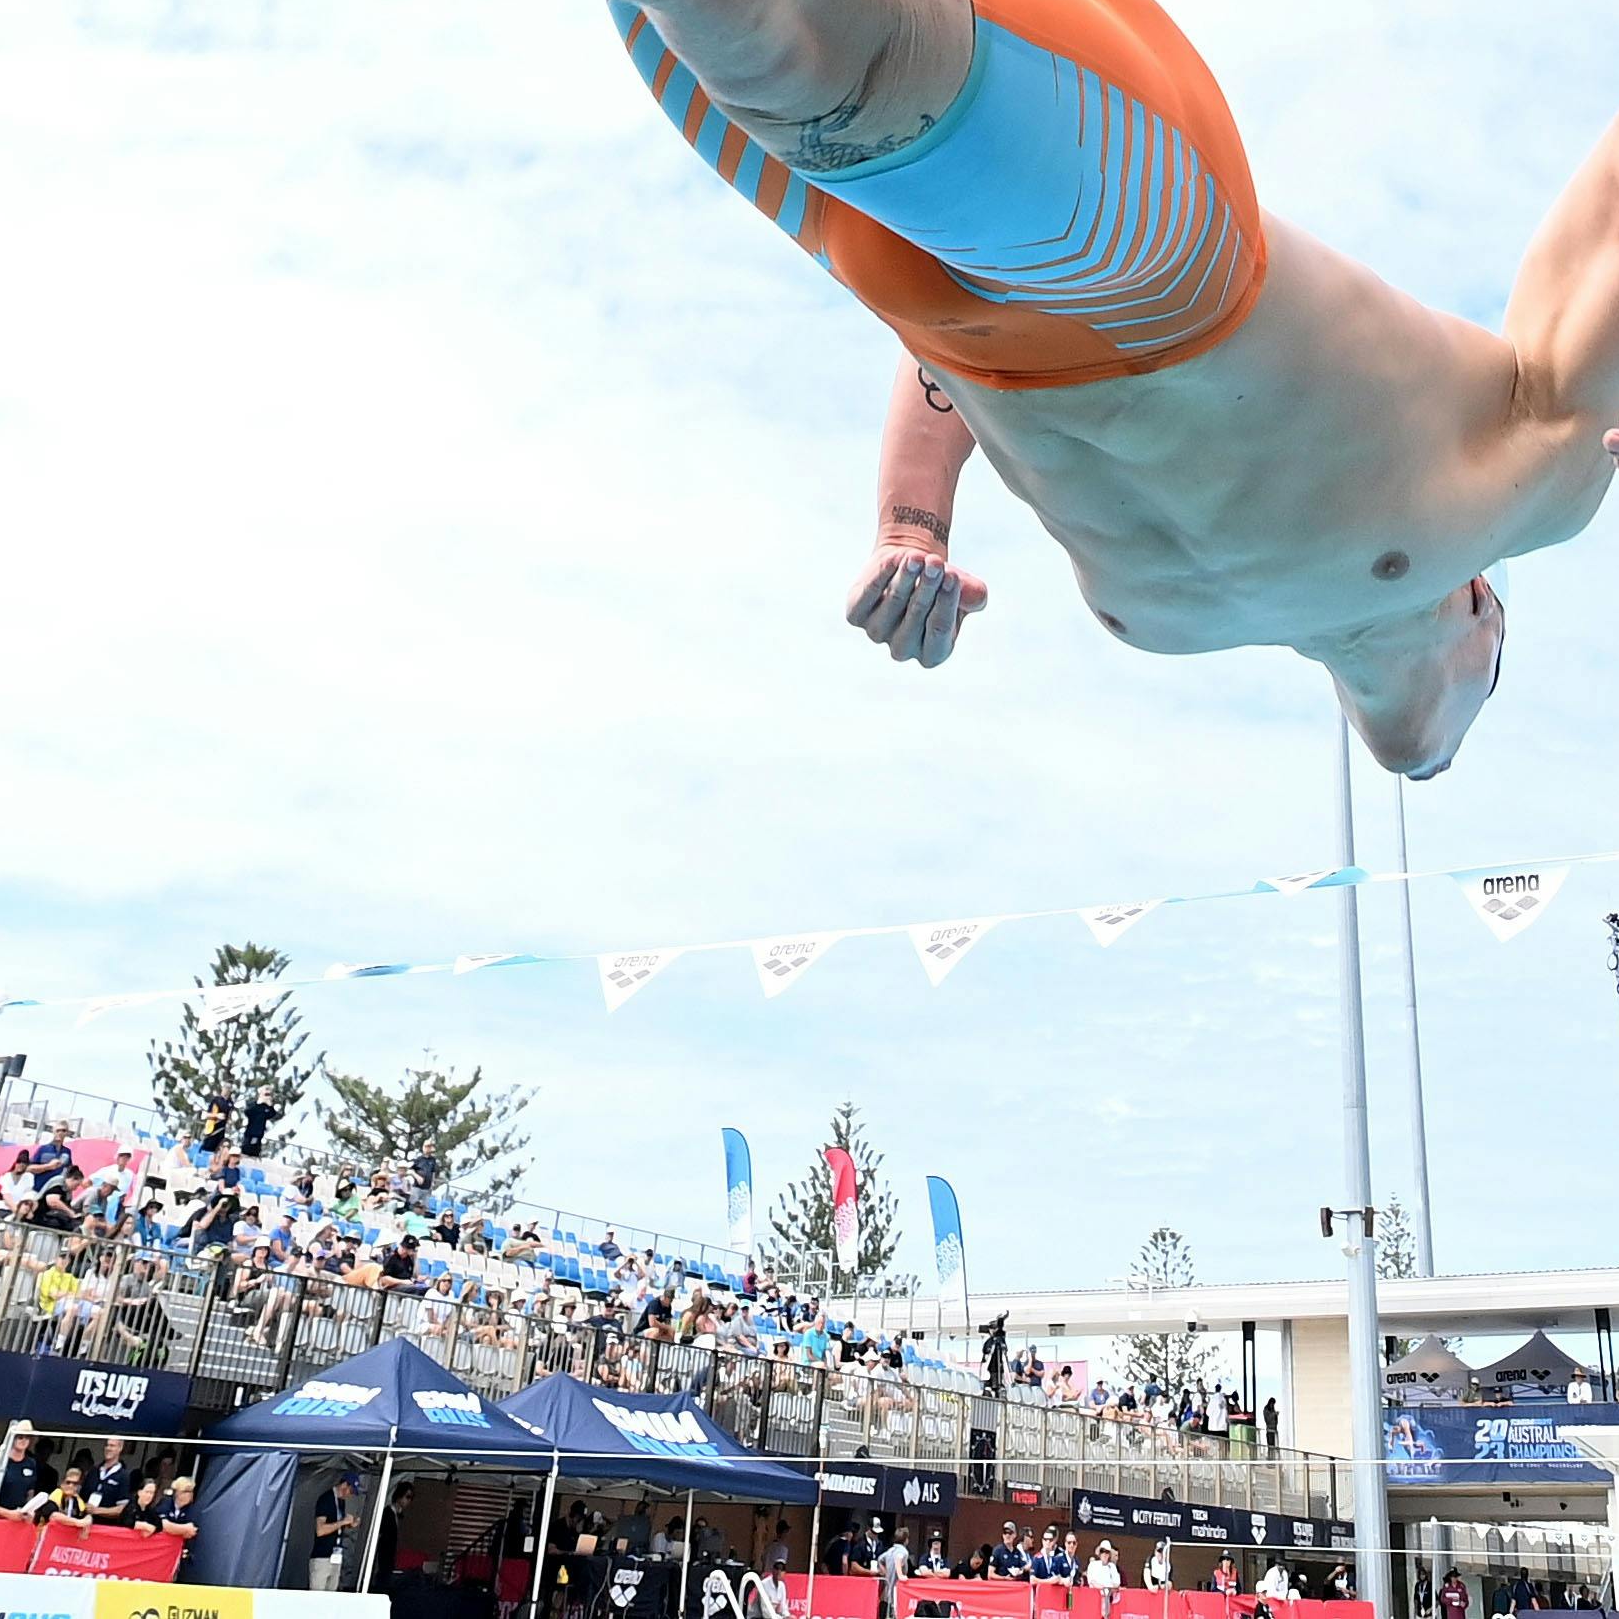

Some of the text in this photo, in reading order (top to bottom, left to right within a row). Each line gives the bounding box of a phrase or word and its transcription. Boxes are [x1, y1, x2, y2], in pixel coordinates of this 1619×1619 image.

[1483, 871, 1540, 895] arena
[929, 922, 978, 943] arena
[769, 940, 816, 957] arena
[613, 953, 659, 969] arena
[1386, 1371, 1417, 1384] arena
[1495, 1369, 1527, 1382] arena
[272, 1397, 361, 1417] AUS
[1475, 1419, 1509, 1442] 20
[921, 1482, 940, 1503] AIS
[50, 1545, 111, 1569] AUSTRALIA'S
